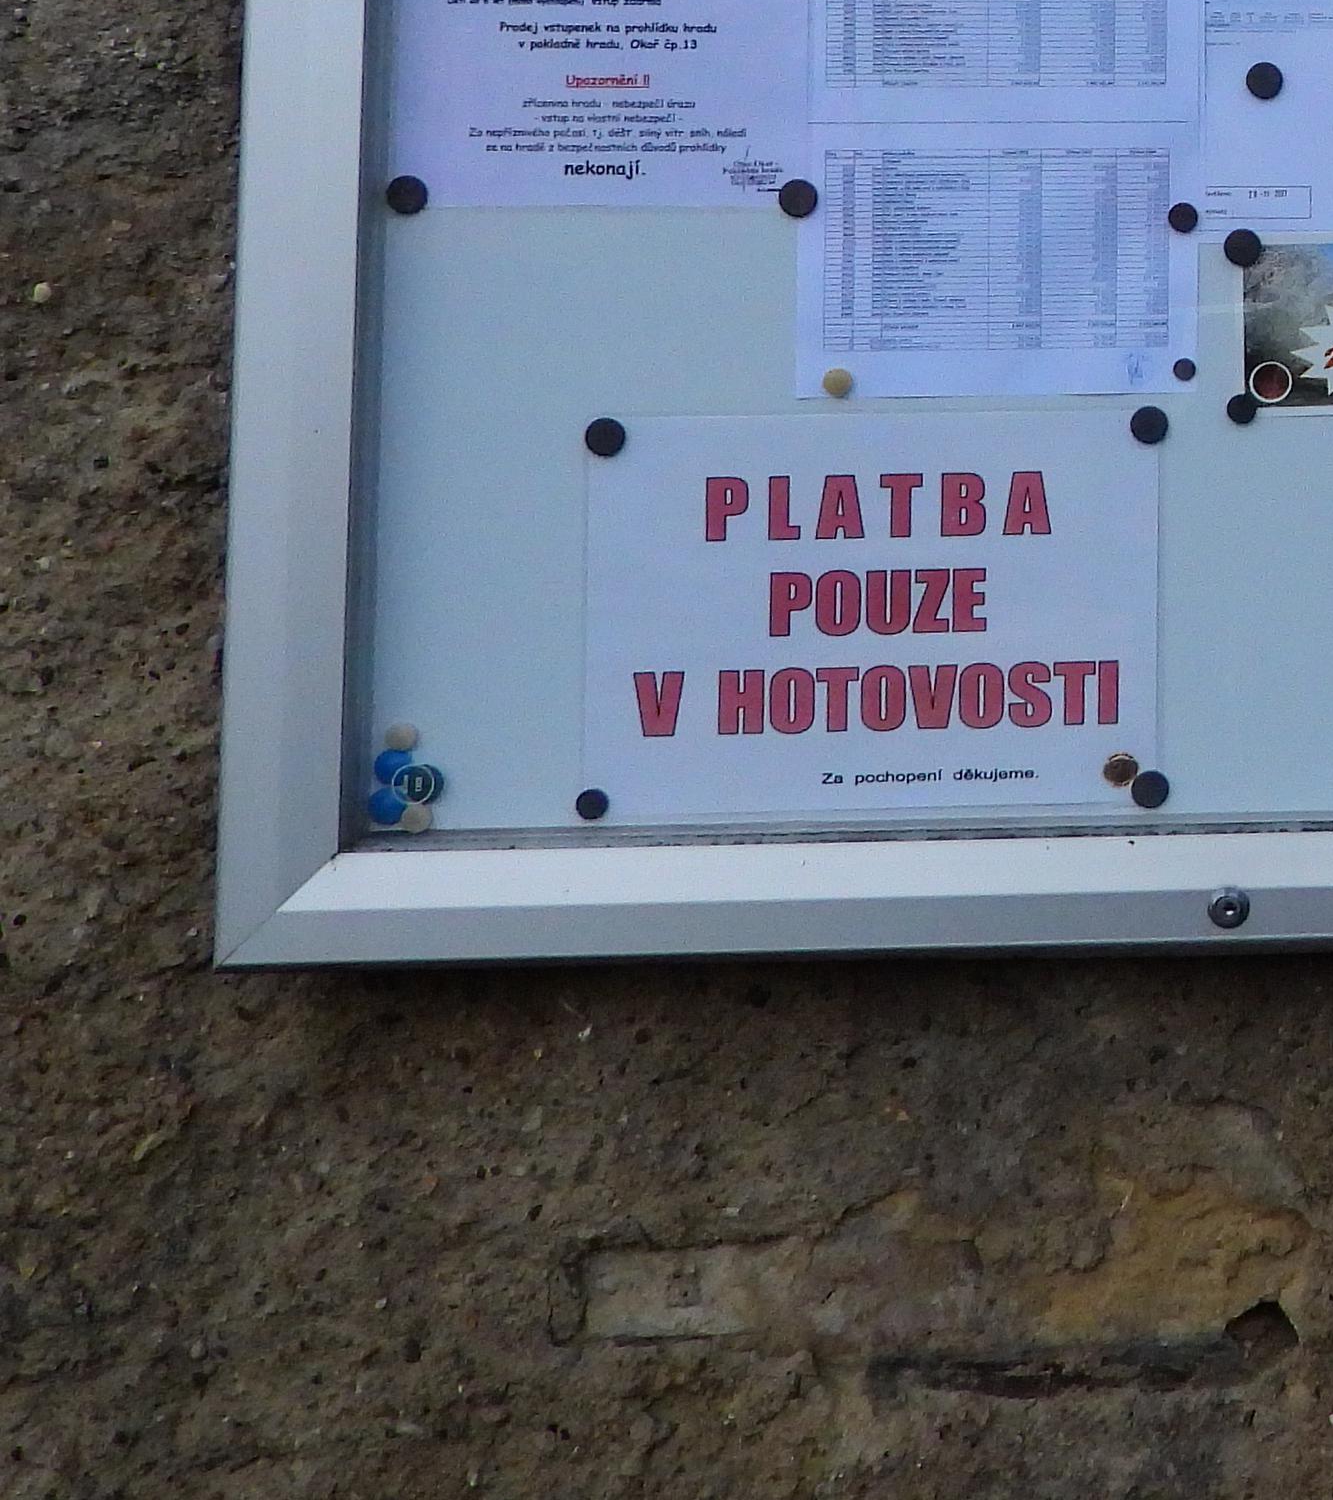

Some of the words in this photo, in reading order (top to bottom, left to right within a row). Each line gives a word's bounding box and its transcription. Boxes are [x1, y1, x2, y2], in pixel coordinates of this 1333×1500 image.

[499, 21, 538, 35] Prodej
[544, 21, 602, 35] vstupenek
[606, 23, 620, 33] na
[625, 20, 678, 35] prohlídku
[683, 21, 717, 34] hradu
[530, 37, 581, 51] pokladně
[630, 37, 659, 50] Okoř
[566, 74, 639, 89] Upozornění
[564, 159, 646, 180] nekonají.
[704, 471, 1052, 542] PLATBA
[768, 568, 987, 637] POUZE
[632, 671, 685, 737] V
[717, 659, 1120, 735] HOTOVOSTI
[821, 772, 844, 785] Za
[854, 769, 943, 786] pochopení
[953, 767, 1039, 783] děkujeme.
